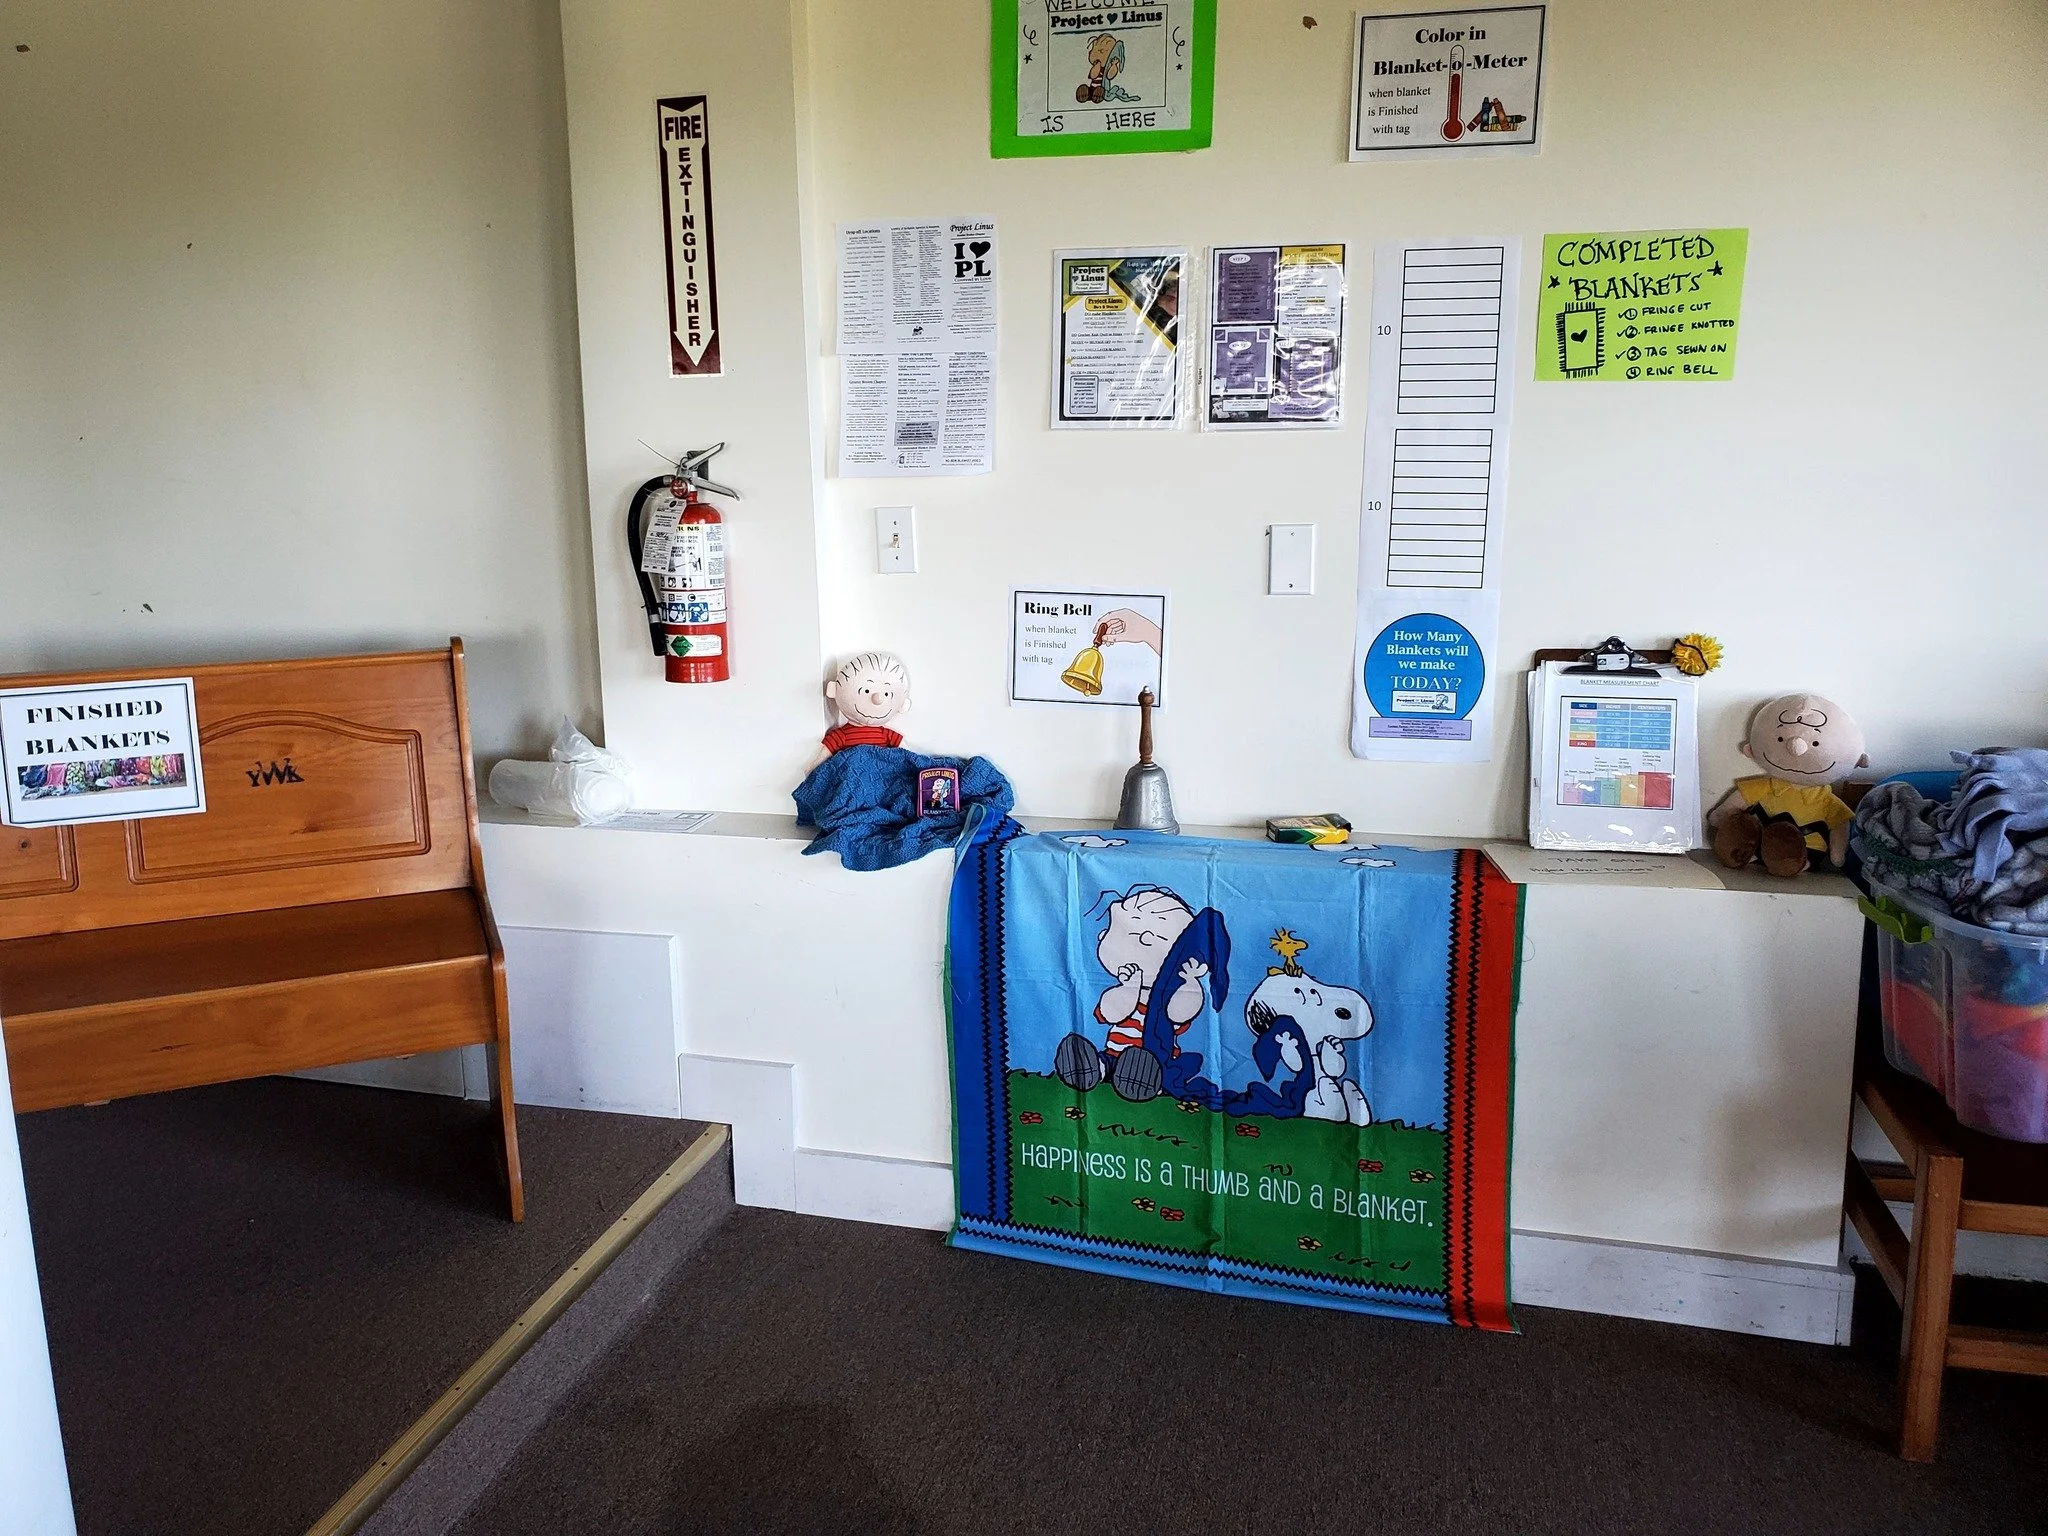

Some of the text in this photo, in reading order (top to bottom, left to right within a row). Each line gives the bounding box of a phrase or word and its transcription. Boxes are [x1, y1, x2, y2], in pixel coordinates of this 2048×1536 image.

[1051, 11, 1163, 28] Project Linus
[1415, 26, 1486, 43] Color in
[1369, 86, 1431, 98] when blanket
[1367, 105, 1418, 117] is Finished
[664, 115, 702, 141] FIRE
[1041, 112, 1155, 133] IS HERE
[1372, 125, 1410, 135] with tag
[950, 224, 972, 234] Project
[678, 147, 701, 347] EXTINGUISHER
[953, 242, 966, 260] I
[1557, 234, 1715, 268] COMPLETED
[954, 260, 992, 278] PL
[1073, 267, 1105, 275] Project
[1568, 272, 1703, 300] BLANKETS
[1642, 304, 1685, 316] FRINGE
[1689, 301, 1712, 312] CUT
[1376, 325, 1392, 337] 10
[1644, 323, 1685, 335] FRINGE
[1691, 319, 1735, 330] KNOTTED
[1644, 347, 1668, 357] TAG
[1676, 344, 1707, 355] SEWN
[1710, 343, 1727, 353] ON
[1646, 366, 1676, 376] RING
[1683, 365, 1718, 375] BELL
[1368, 501, 1381, 512] 10
[1024, 602, 1092, 616] Ring Bell
[1025, 625, 1077, 635] when blanket
[1024, 640, 1067, 649] is Finished
[1394, 631, 1462, 644] How Many
[1387, 645, 1469, 656] Blankets will
[1022, 655, 1053, 665] with tag
[1399, 660, 1456, 670] we make
[1391, 675, 1462, 690] TODAY?
[26, 700, 163, 724] FINISHED
[26, 730, 170, 755] BLANKETS
[1134, 1163, 1152, 1183] IS
[1159, 1164, 1173, 1186] a
[1181, 1164, 1250, 1197] THUMB
[1309, 1189, 1324, 1209] a
